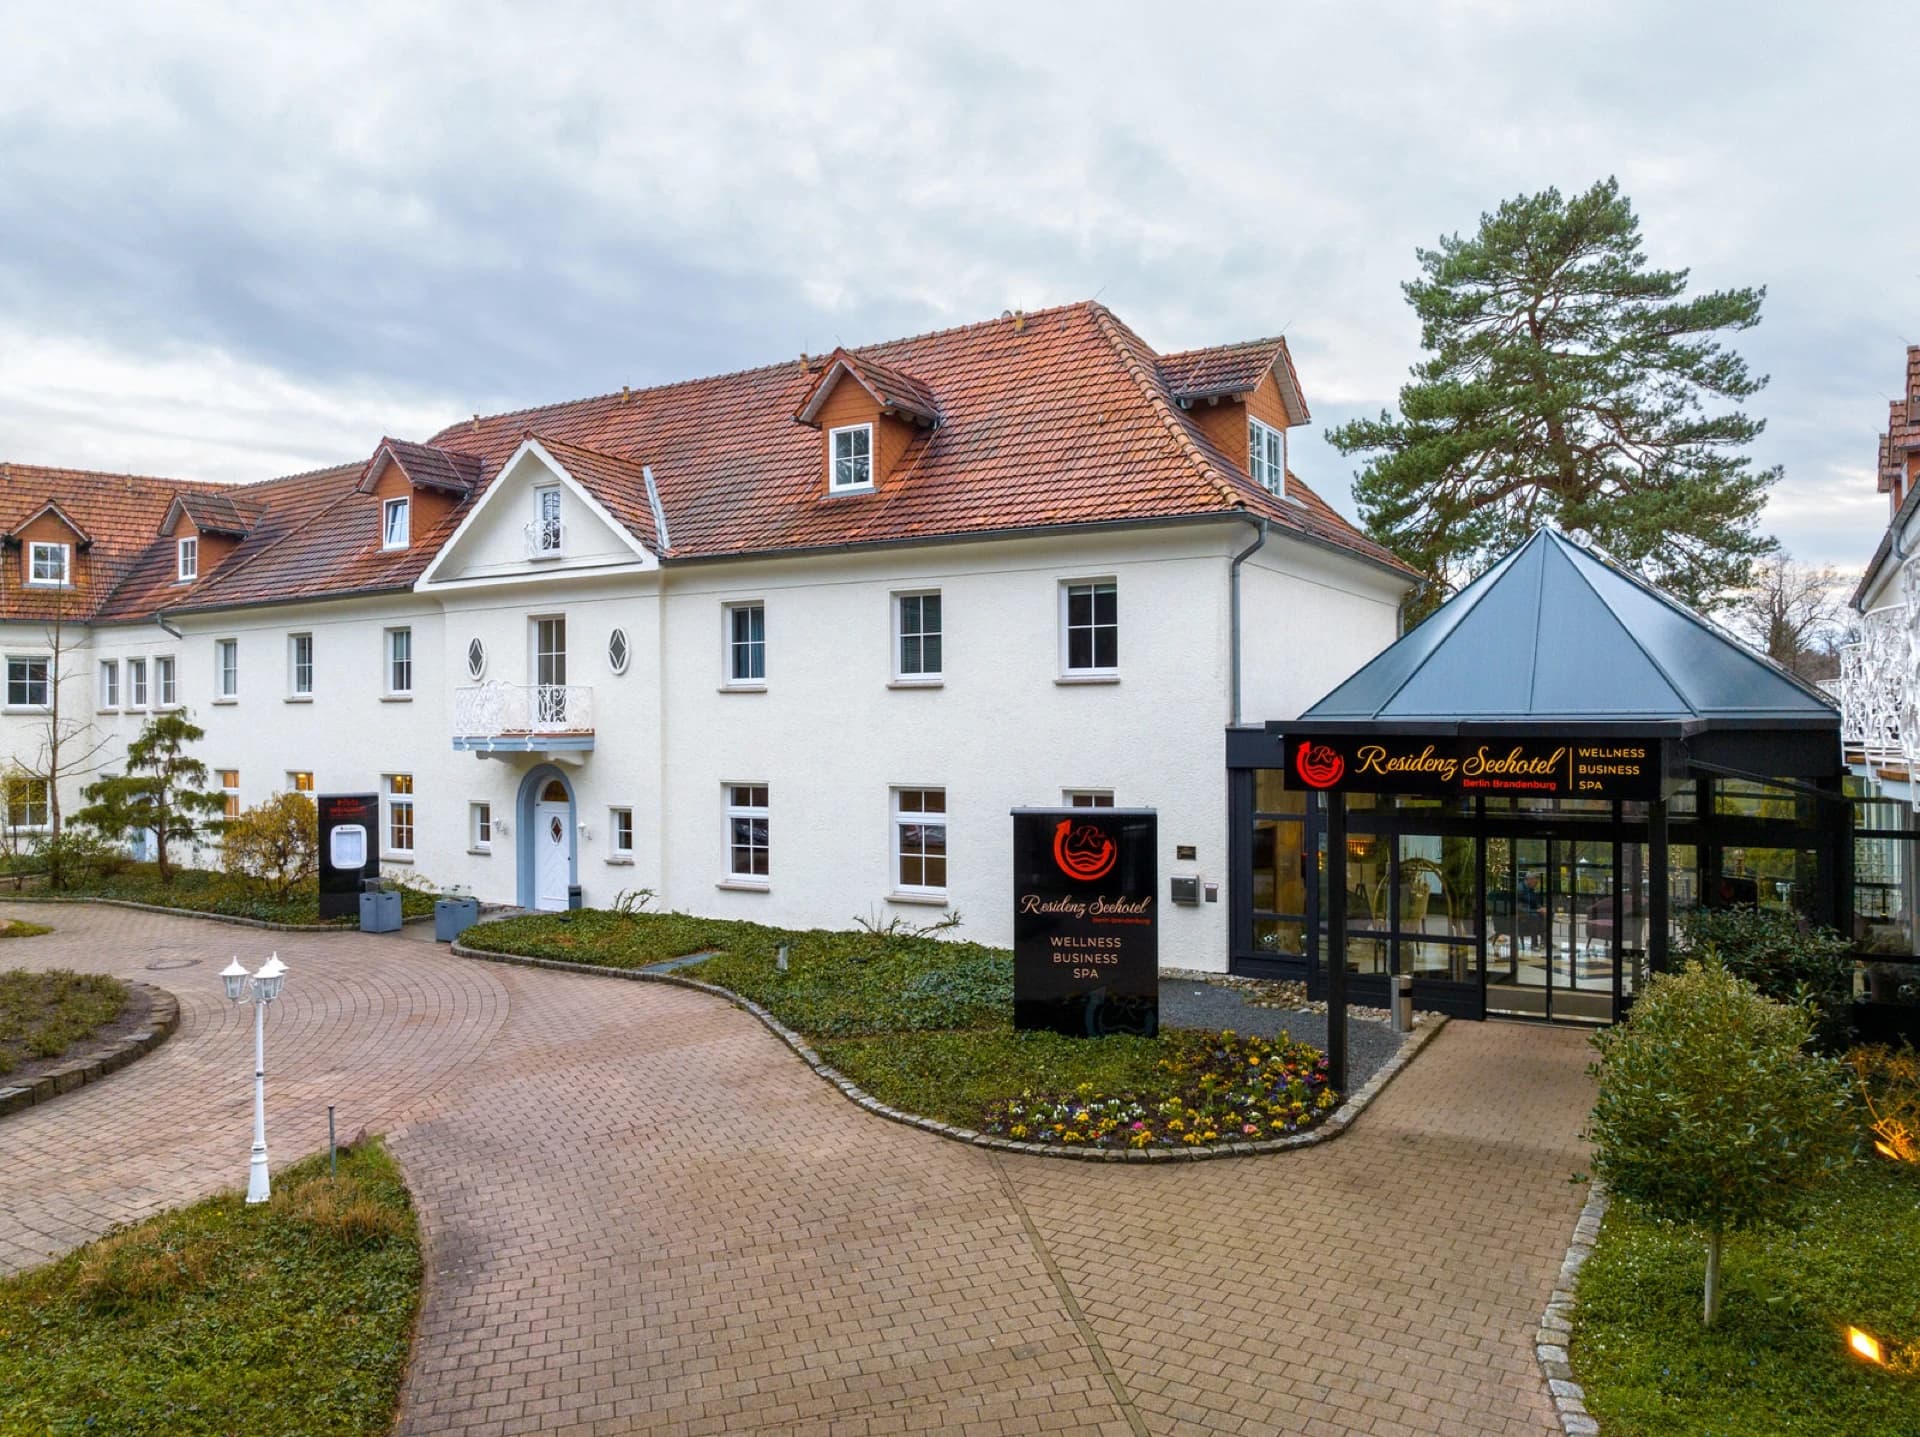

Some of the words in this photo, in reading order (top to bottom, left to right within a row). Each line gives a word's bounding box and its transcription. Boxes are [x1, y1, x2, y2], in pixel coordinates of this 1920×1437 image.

[1578, 748, 1645, 759] WELLNESS
[1355, 745, 1457, 781] Residenz
[1462, 746, 1565, 775] Seehotel
[1578, 765, 1640, 775] BUSINESS
[1463, 779, 1490, 788] Berlin
[1493, 780, 1557, 791] Brandenburg
[1578, 781, 1603, 790] SPA
[1020, 894, 1087, 919] Residenz
[1089, 895, 1152, 915] Seehotel
[1050, 936, 1122, 948] WELLNESS
[1053, 953, 1118, 964] BUSINESS
[1073, 968, 1099, 979] SPA
